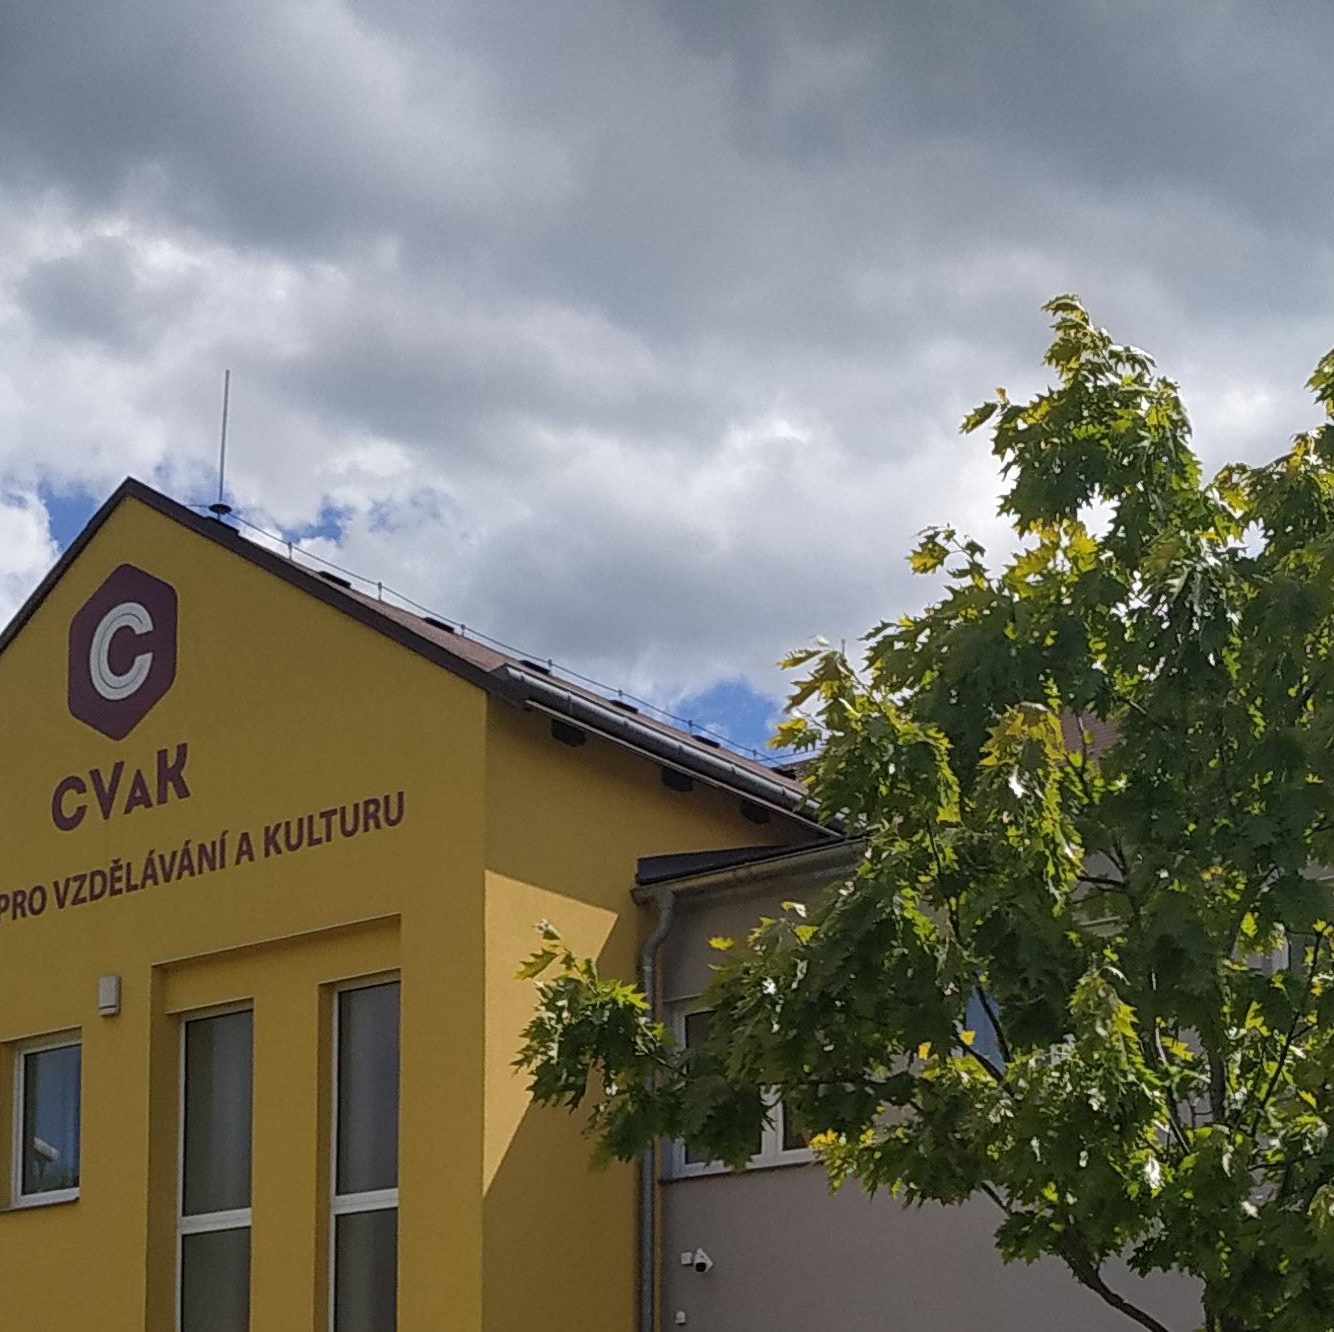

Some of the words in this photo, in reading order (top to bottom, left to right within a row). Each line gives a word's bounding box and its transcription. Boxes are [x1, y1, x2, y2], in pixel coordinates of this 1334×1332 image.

[53, 827, 229, 910] VZDĚLÁVÁNÍ
[234, 830, 255, 867] A
[263, 790, 406, 859] KULTURU
